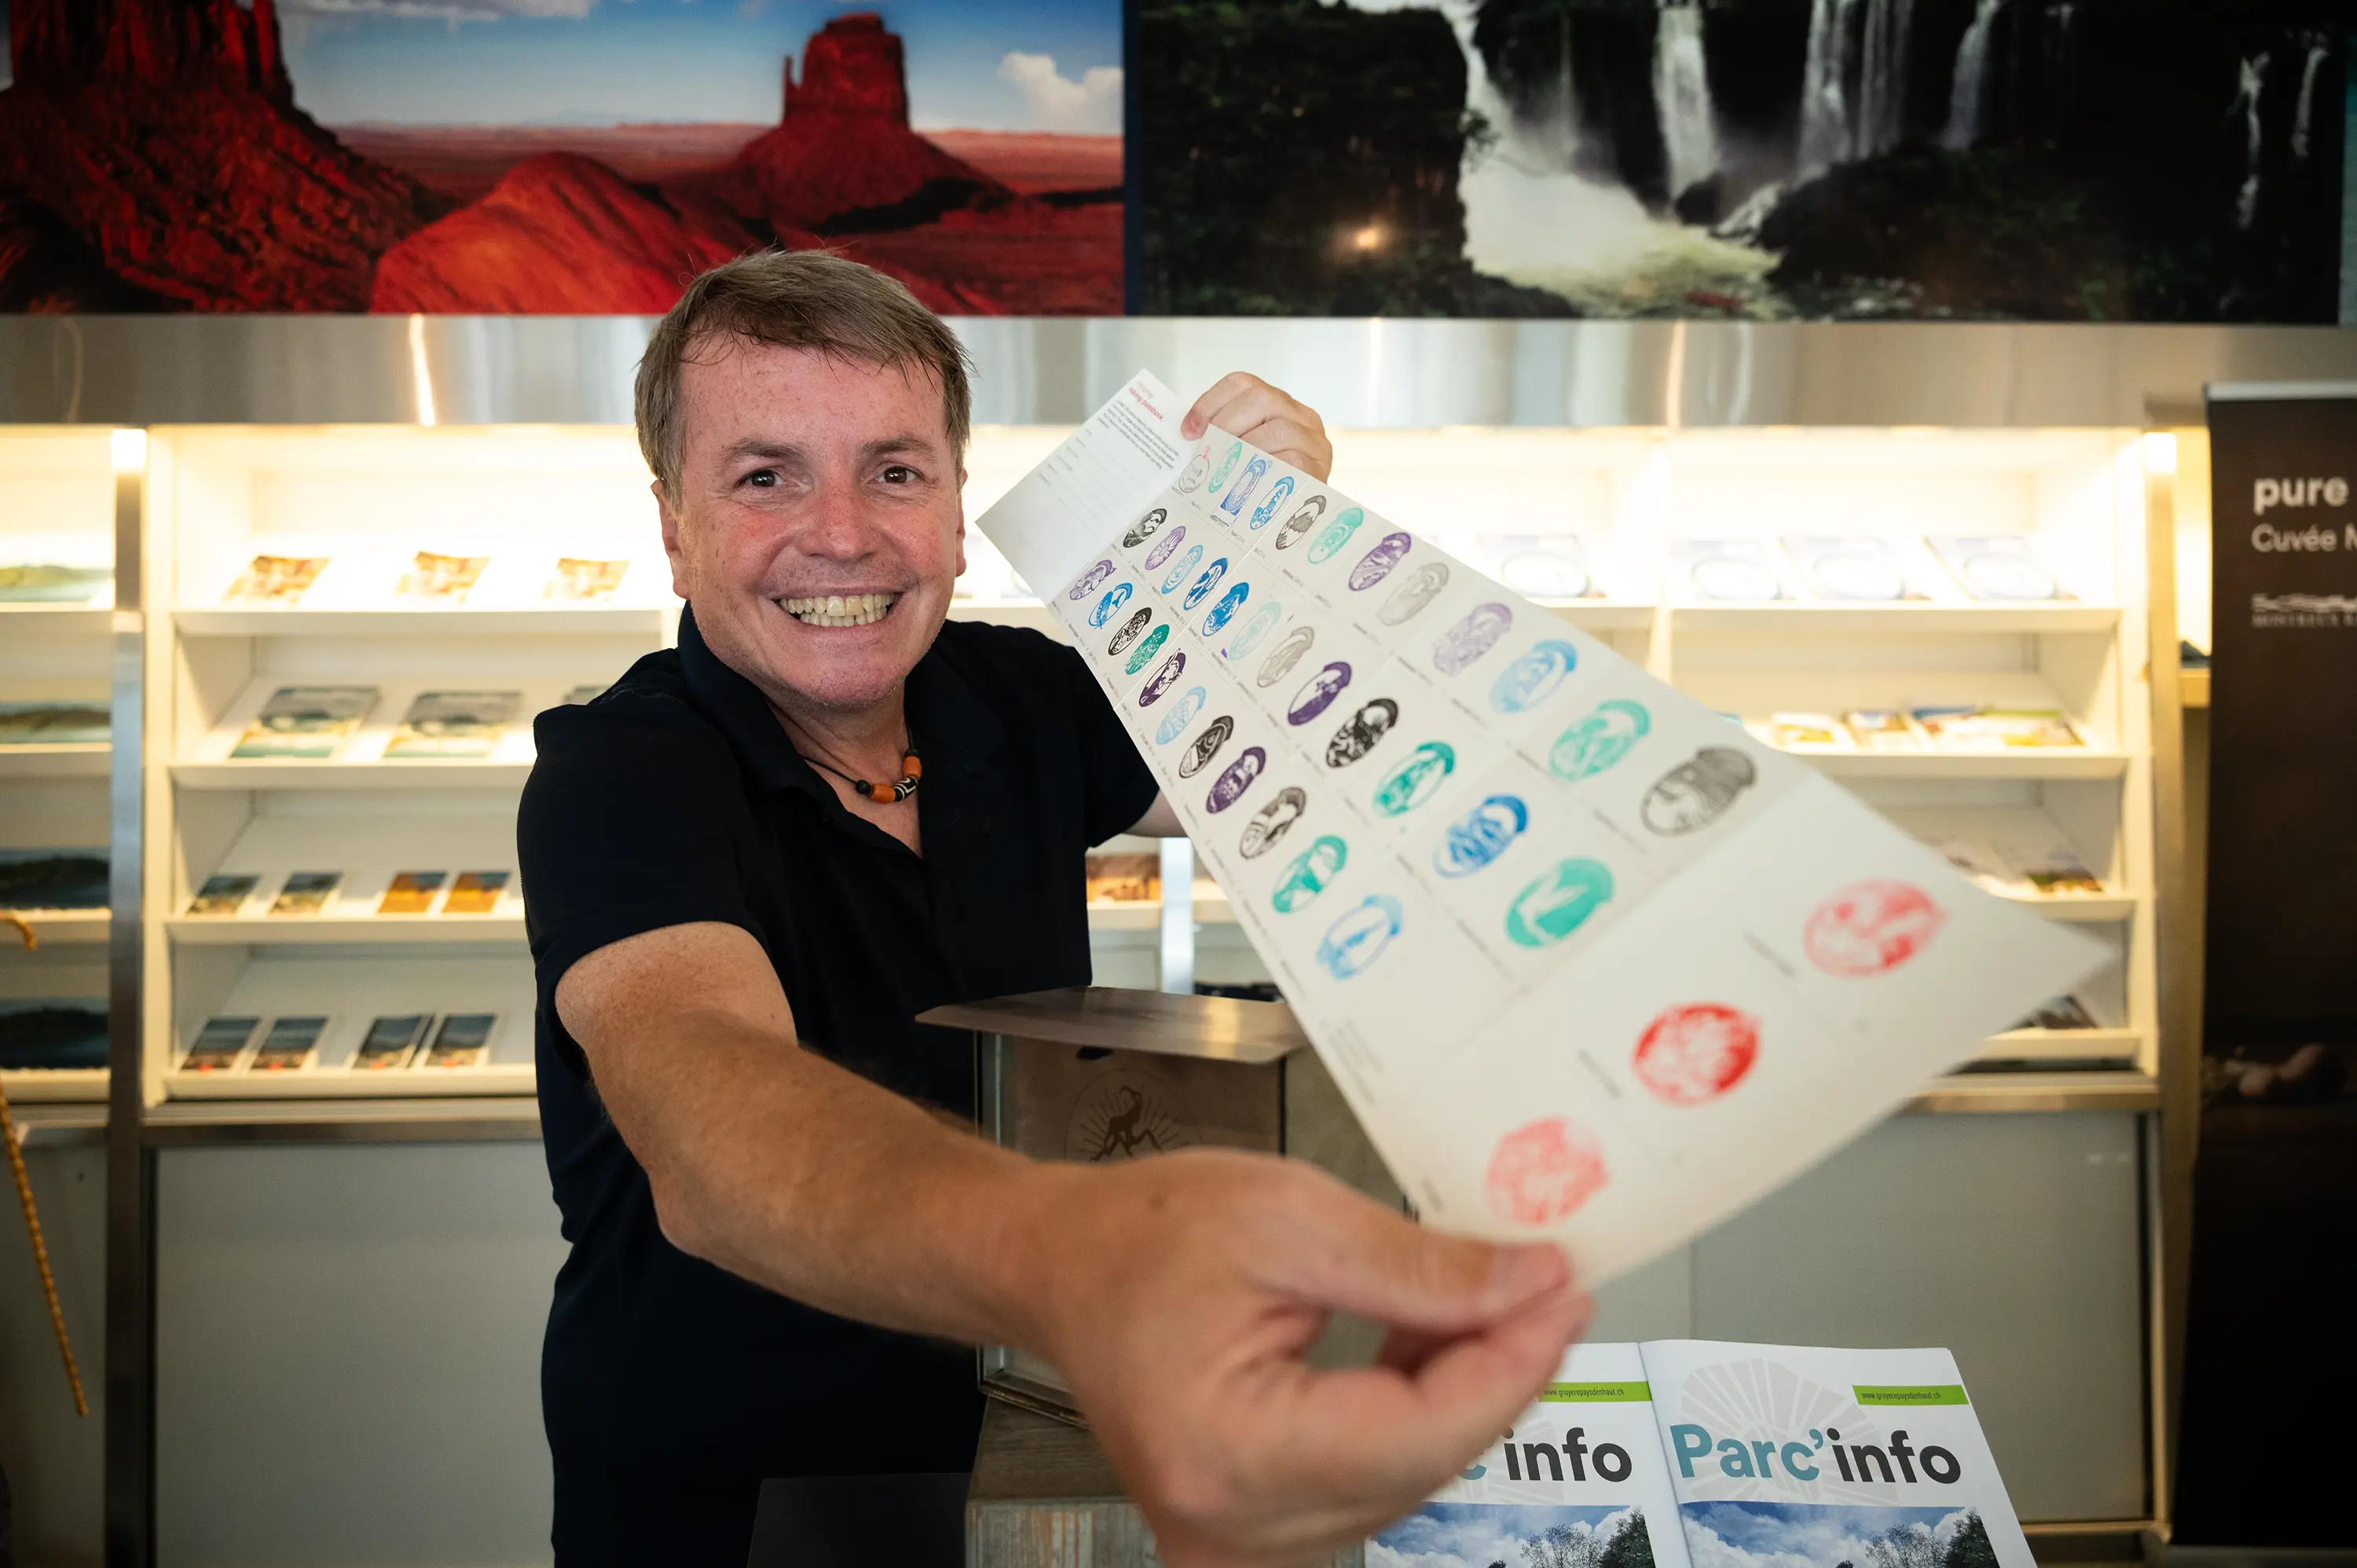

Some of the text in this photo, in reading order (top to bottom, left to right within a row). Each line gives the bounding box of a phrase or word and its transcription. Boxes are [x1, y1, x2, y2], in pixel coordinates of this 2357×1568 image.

[2253, 476, 2350, 516] pure
[2251, 522, 2338, 551] Cuvée
[1543, 1387, 1625, 1398] www.gruyerepaysdenhaut.ch
[1860, 1391, 1941, 1401] www.gruyerepaysdenhaut.ch
